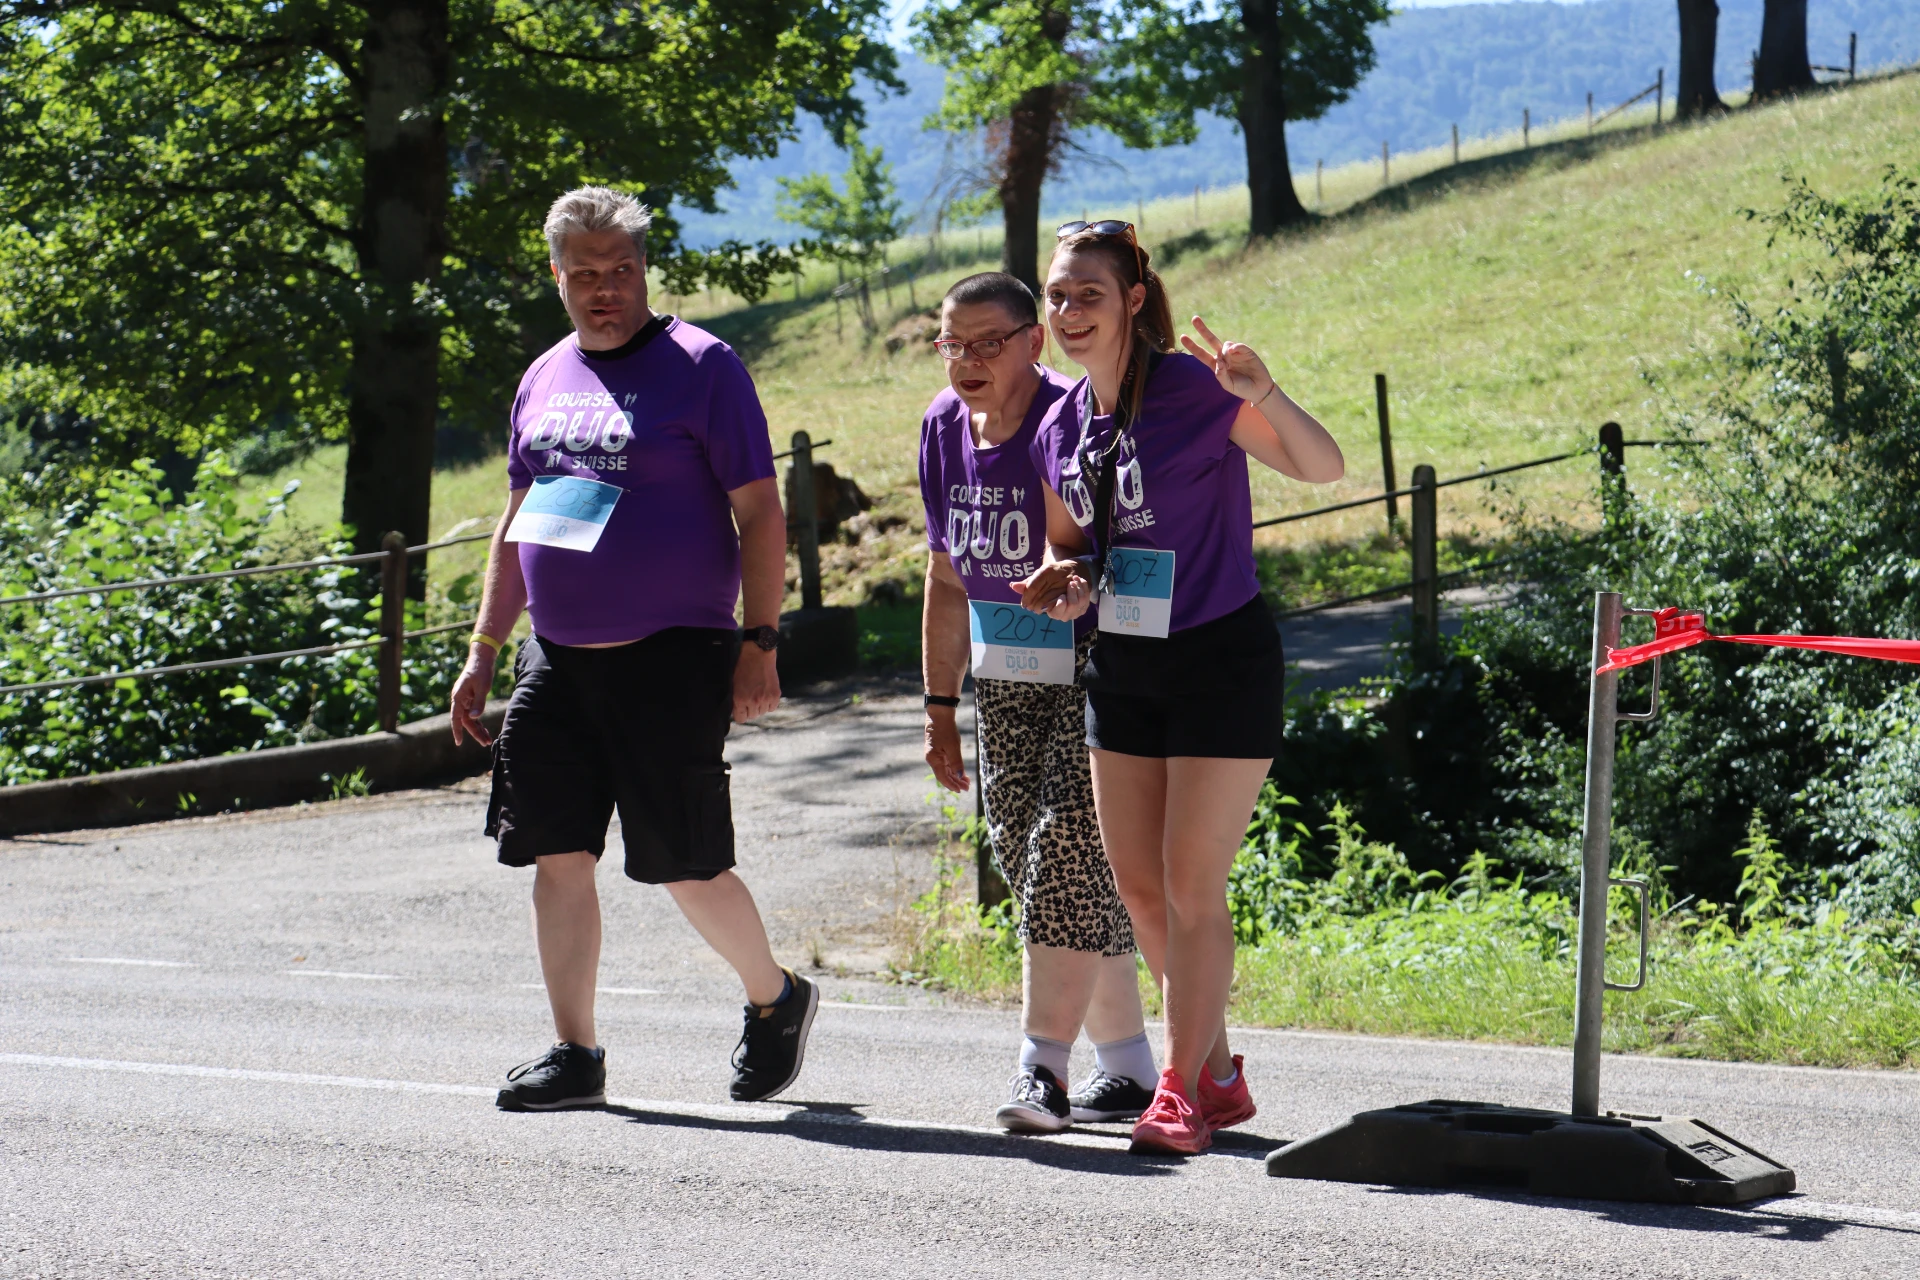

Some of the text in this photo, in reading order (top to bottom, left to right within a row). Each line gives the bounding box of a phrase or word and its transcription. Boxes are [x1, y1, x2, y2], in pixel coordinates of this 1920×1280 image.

[548, 393, 616, 407] COURSE
[530, 410, 634, 453] DUO
[572, 456, 627, 470] SUISSE
[536, 481, 602, 514] 207
[949, 484, 1004, 506] COURSE
[1062, 459, 1144, 527] DO
[948, 508, 1030, 561] DUO
[980, 560, 1036, 579] SUISSE
[1111, 553, 1158, 588] 207
[1115, 604, 1141, 622] DUO
[1005, 654, 1039, 671] DUO
